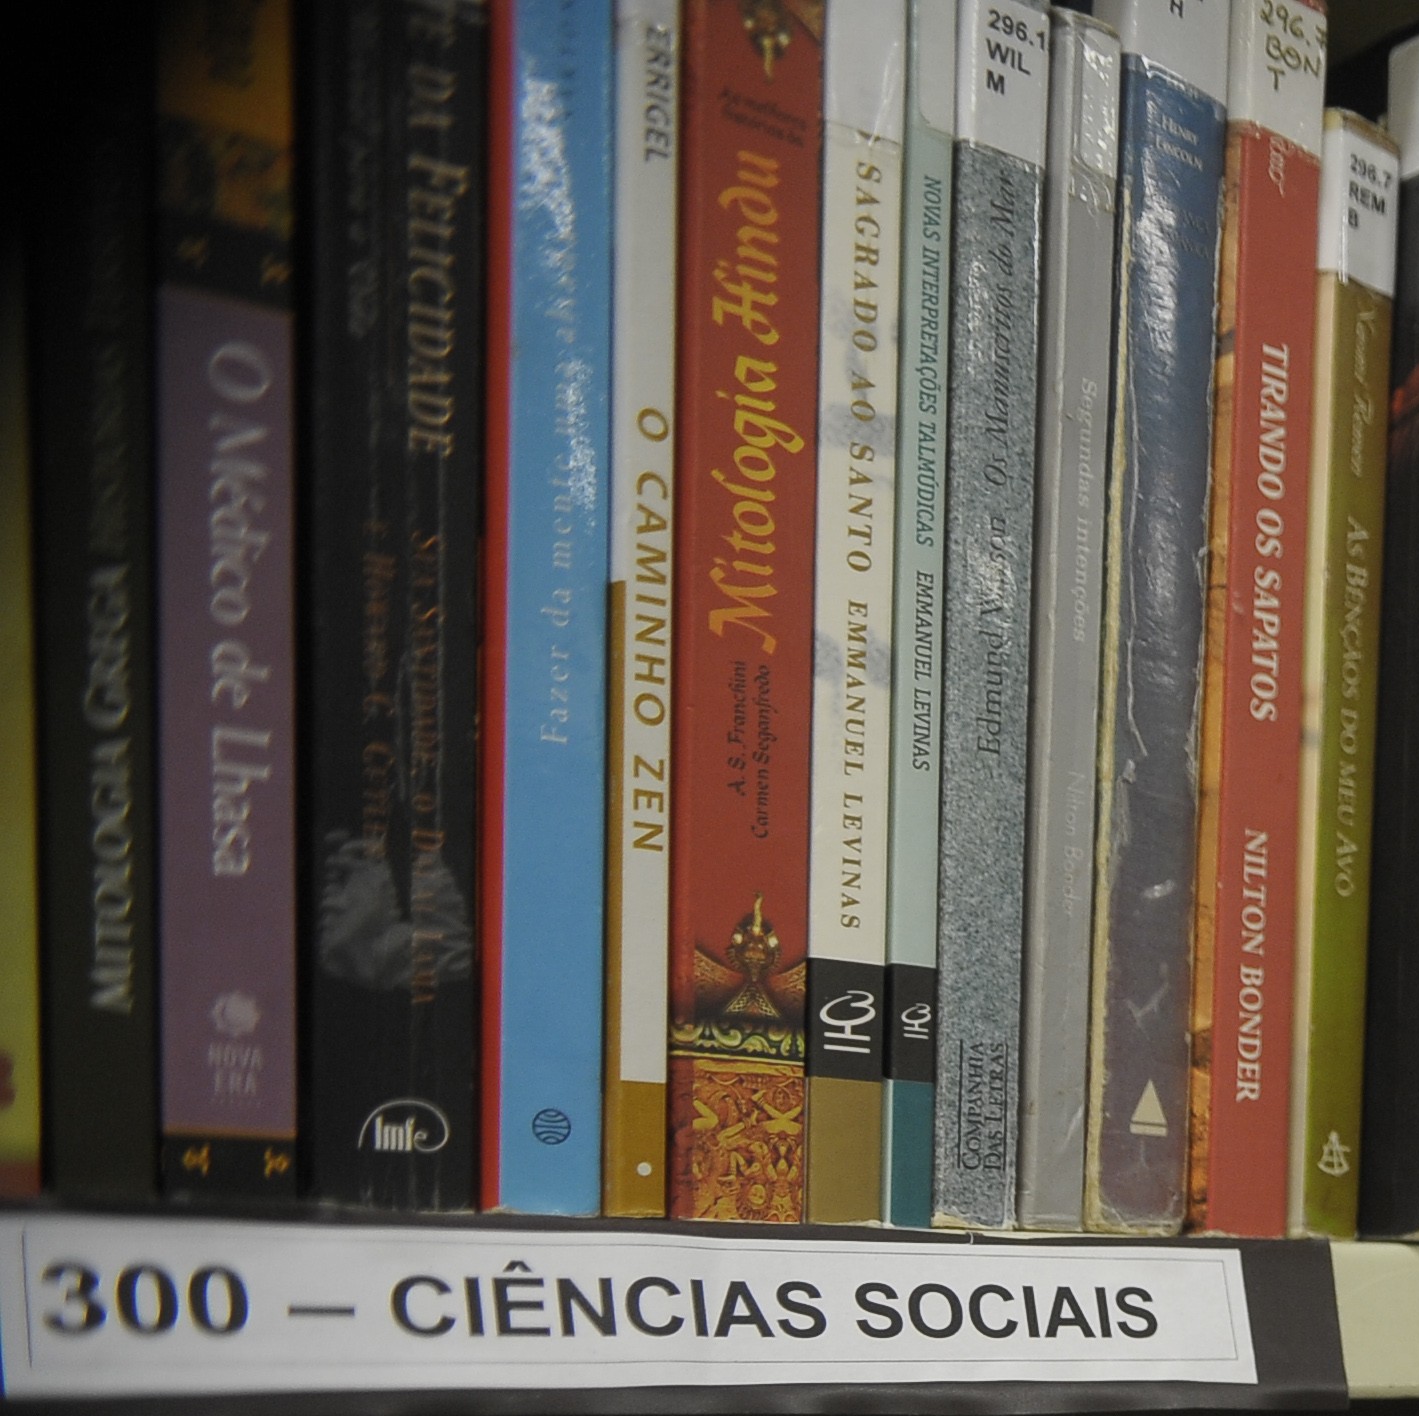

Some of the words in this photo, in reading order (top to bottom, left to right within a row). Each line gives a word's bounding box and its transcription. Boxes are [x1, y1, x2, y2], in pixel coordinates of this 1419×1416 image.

[985, 37, 1032, 77] WIL
[986, 68, 1006, 95] M
[988, 8, 1046, 53] 296.1
[1264, 32, 1321, 78] BON
[1266, 65, 1286, 92] T
[711, 150, 781, 345] Hindu
[850, 162, 882, 354] SAGRADO
[921, 174, 942, 241] NOVAS
[407, 155, 469, 457] FELICIDADE
[915, 246, 943, 415] INTERPRETAÇÕES
[207, 341, 271, 403] O
[637, 408, 669, 443] O
[848, 373, 876, 424] AO
[1256, 342, 1290, 502] TIRANDO
[915, 420, 941, 547] TALMÚDICAS
[1077, 378, 1098, 509] Segundas
[208, 413, 271, 628] Médico
[551, 452, 574, 568] mente
[707, 355, 806, 655] Mitologia
[846, 441, 877, 574] SANTO
[1252, 509, 1285, 560] OS
[538, 587, 571, 627] da
[633, 472, 668, 728] CAMINHO
[913, 571, 934, 681] EMMANUEL
[1070, 515, 1096, 643] intenções
[211, 642, 271, 711] de
[538, 643, 571, 747] Fazer
[843, 599, 869, 777] EMMANUEL
[976, 631, 1005, 756] Edmund
[1247, 565, 1282, 723] SAPATOS
[727, 660, 750, 747] Franchini
[751, 664, 777, 765] Seganfredo
[911, 688, 932, 771] LEVINAS
[211, 725, 271, 878] Lhasa
[631, 756, 665, 853] ZEN
[751, 767, 773, 839] Carmen
[88, 737, 134, 1014] MITOLOGIA
[839, 792, 864, 930] LEVINAS
[1061, 845, 1085, 919] Bonder
[1240, 828, 1269, 955] NILTON
[983, 1042, 1005, 1122] LETRAS
[1236, 966, 1265, 1106] BONDER
[960, 1041, 985, 1171] COMPANHIA
[983, 1129, 1003, 1172] DAS
[40, 1260, 250, 1340] 300
[388, 1260, 827, 1340] CIÊNCIAS
[854, 1278, 1160, 1341] SOCIAIS
